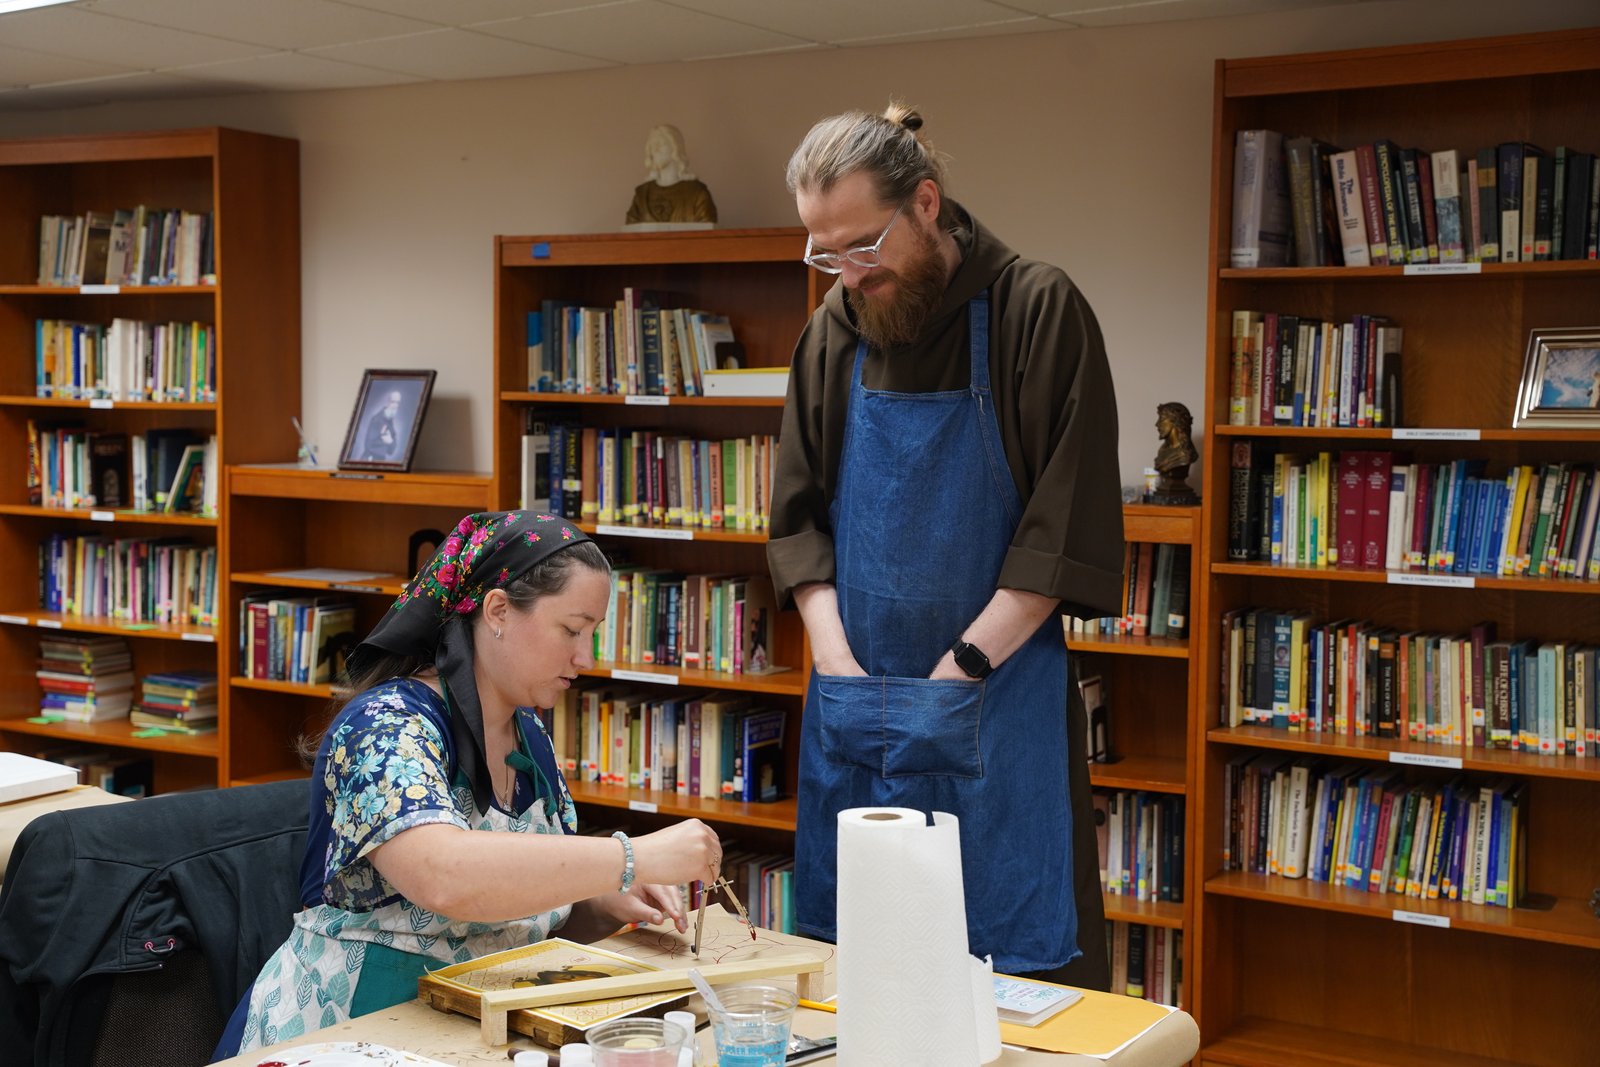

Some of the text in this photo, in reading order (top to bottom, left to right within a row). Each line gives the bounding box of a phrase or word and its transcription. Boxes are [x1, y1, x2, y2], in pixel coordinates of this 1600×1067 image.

[1336, 159, 1350, 217] Bible Almanac
[1346, 178, 1354, 194] The
[1381, 153, 1398, 245] ENCYCLOPEDIA OF THE BIBLE
[1369, 200, 1381, 243] HANDBOOK
[1262, 346, 1273, 412] Medieval Christianity
[1239, 469, 1250, 523] Dictionary
[1499, 660, 1509, 722] LIFE OF CHRIST
[1479, 800, 1488, 837] PREACHING
[1474, 875, 1482, 892] NEWS
[1475, 853, 1483, 873] GOOD
